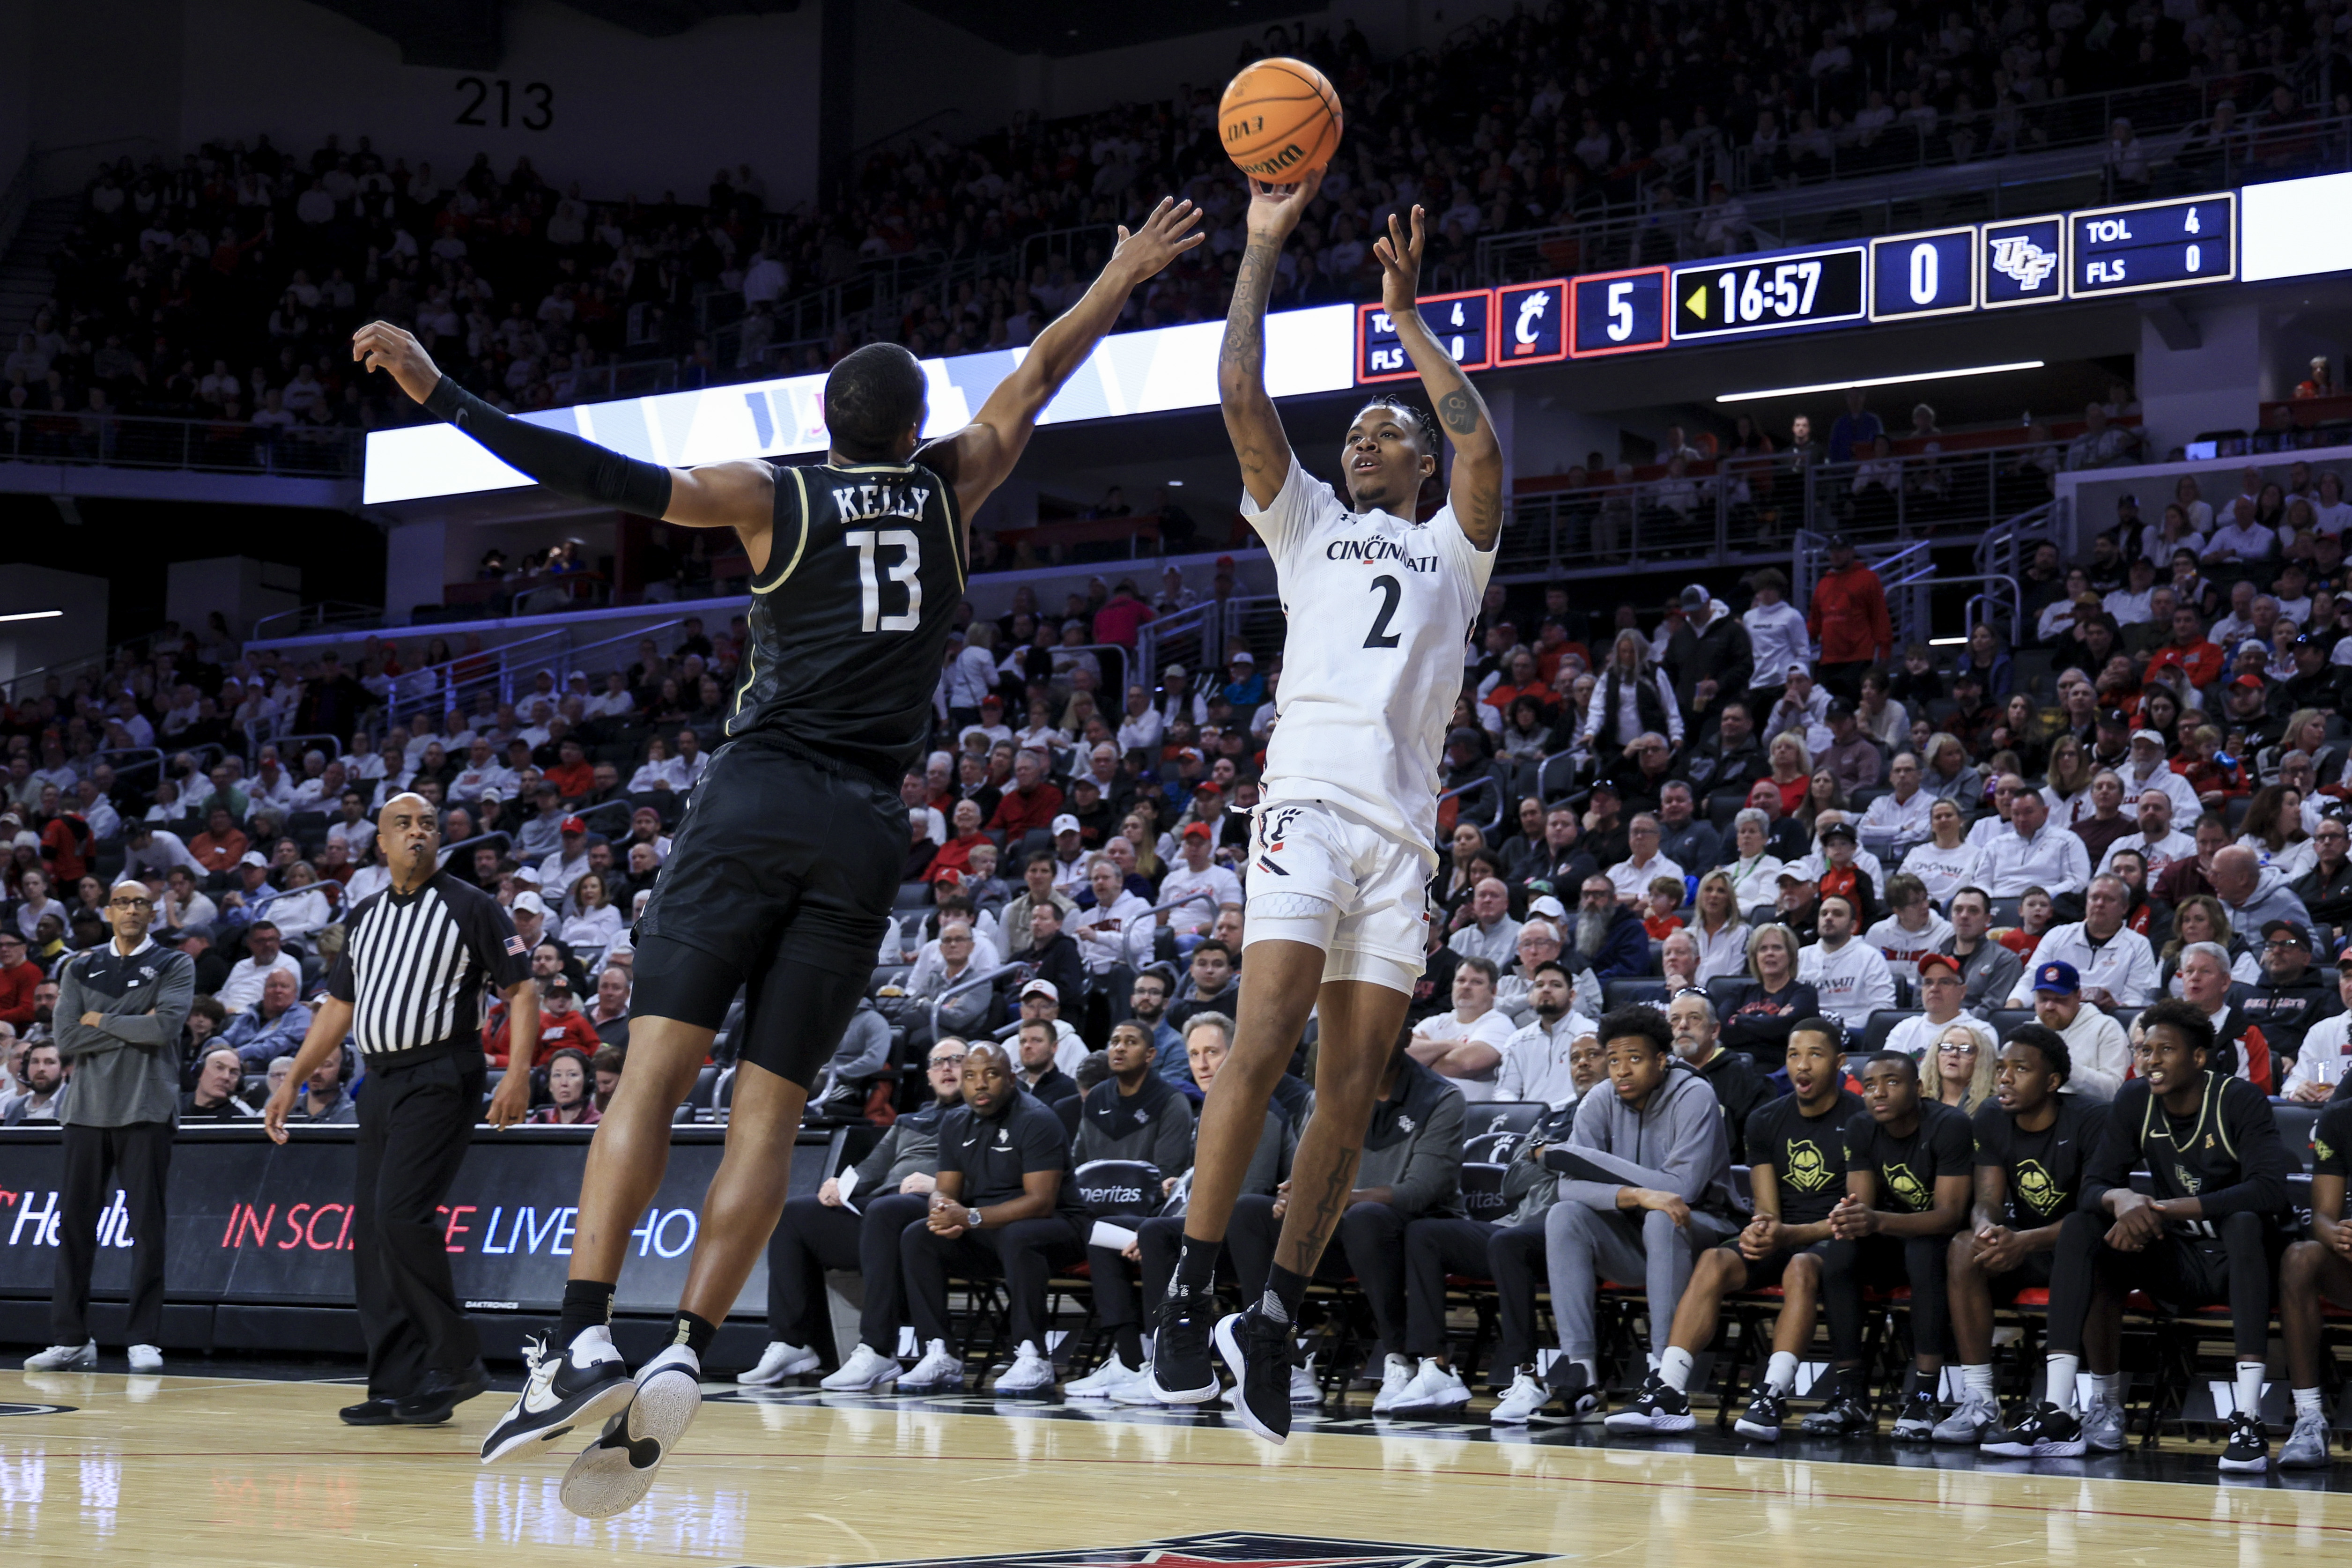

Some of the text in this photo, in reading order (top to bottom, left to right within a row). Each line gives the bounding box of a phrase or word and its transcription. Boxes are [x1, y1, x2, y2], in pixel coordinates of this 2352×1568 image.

[456, 76, 553, 131] 213
[2086, 206, 2201, 244] TOL 4
[1910, 242, 1938, 304] 0
[1990, 236, 2057, 291] UCF
[2086, 244, 2201, 284] FLS 0
[1372, 301, 1465, 333] TO 4
[1607, 281, 1634, 341] 5
[1718, 261, 1821, 324] 16:57
[1372, 335, 1465, 370] FLS 0
[832, 485, 930, 524] KELLY
[845, 529, 922, 632] 13
[1362, 575, 1402, 649] 2
[222, 1203, 276, 1248] IN
[278, 1203, 478, 1253] SCIE
